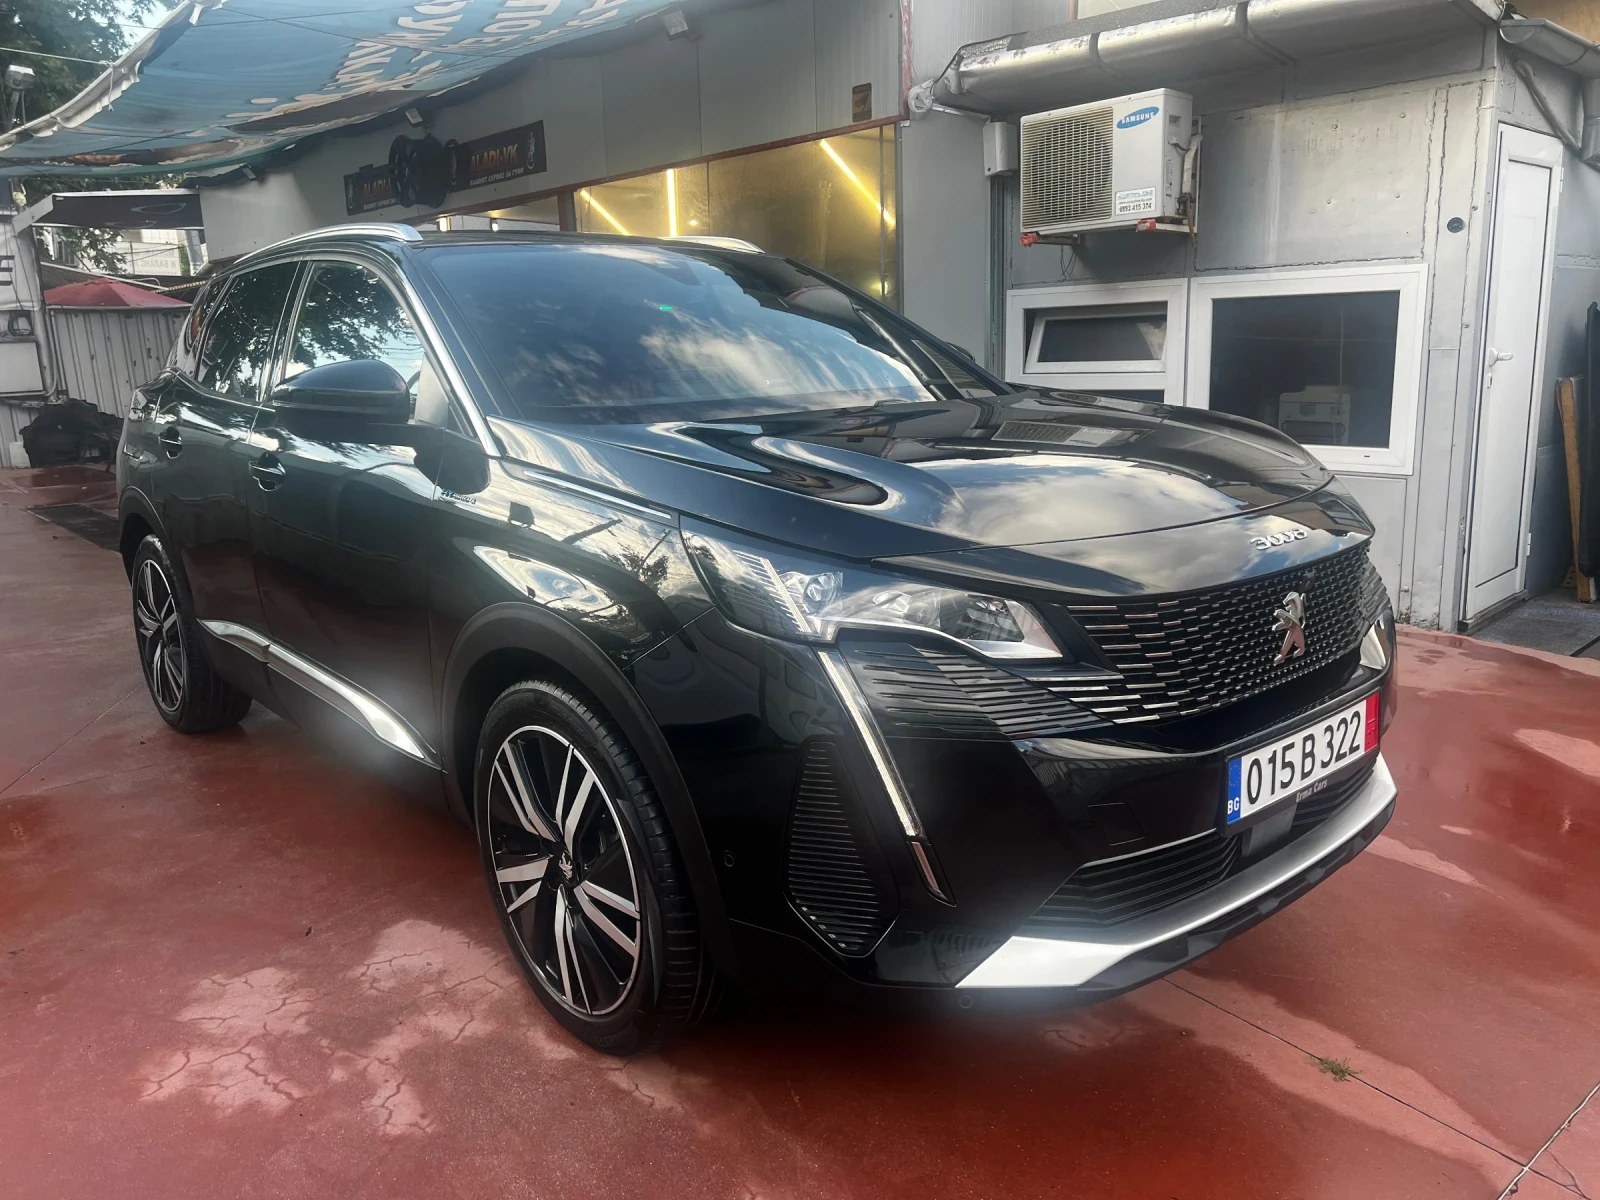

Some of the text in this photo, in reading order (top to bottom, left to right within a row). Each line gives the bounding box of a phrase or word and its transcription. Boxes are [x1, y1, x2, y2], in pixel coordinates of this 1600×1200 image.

[1121, 111, 1155, 124] SAMSUNG
[470, 143, 519, 174] ALADI-VK
[1313, 778, 1328, 793] Cars
[1227, 797, 1240, 815] BG
